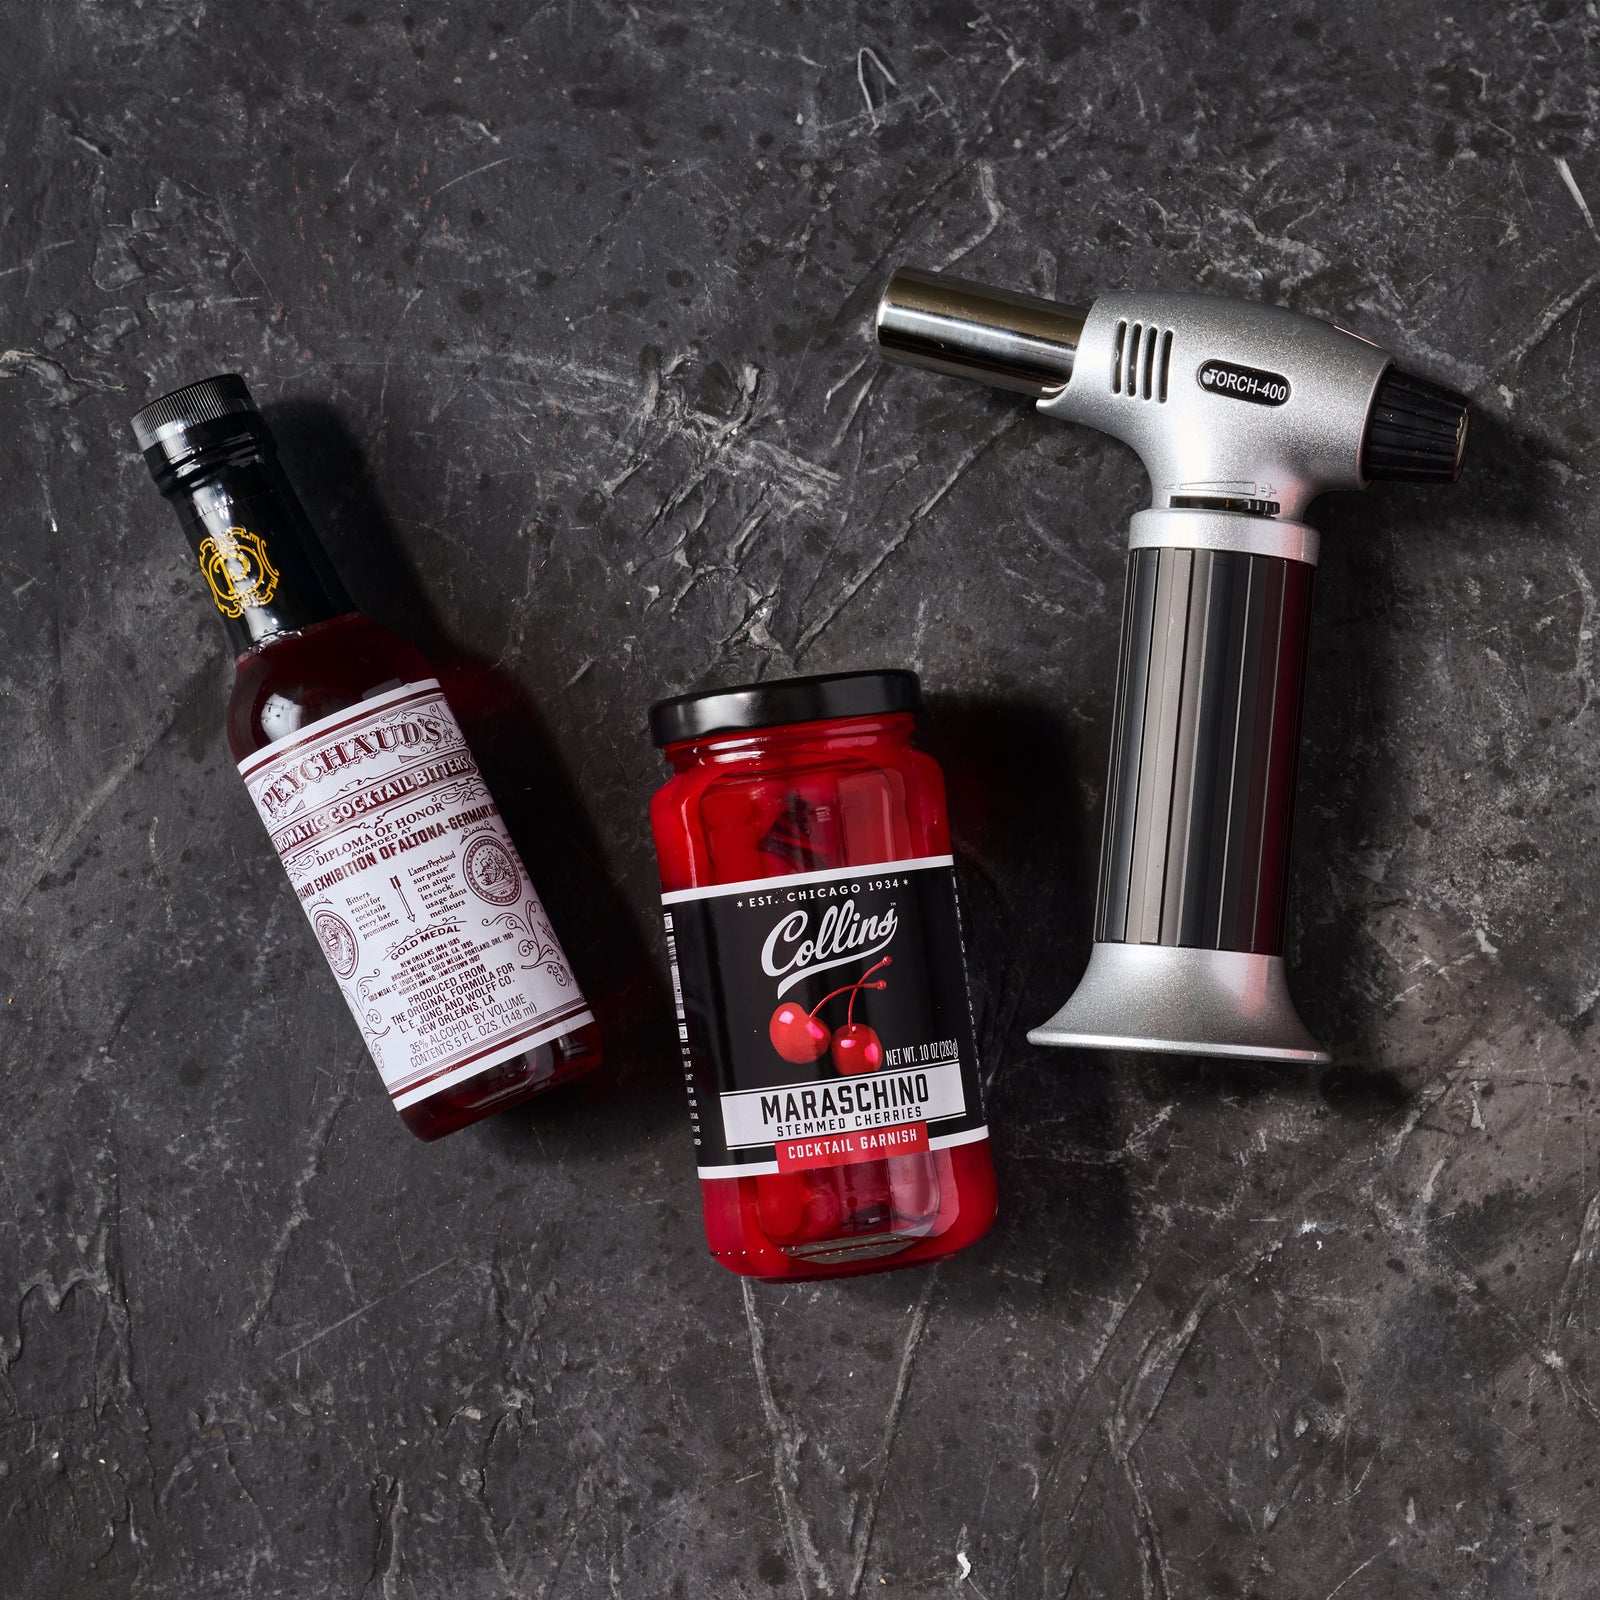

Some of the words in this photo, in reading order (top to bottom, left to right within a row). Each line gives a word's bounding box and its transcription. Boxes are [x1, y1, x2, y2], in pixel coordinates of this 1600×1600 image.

[1208, 368, 1287, 401] TORCH-400
[261, 716, 443, 818] PEYCHAUD'S
[327, 775, 417, 824] COCKTAIL
[415, 755, 471, 788] BITTERS
[316, 833, 373, 866] DIPLOMA
[375, 822, 394, 838] OF
[395, 802, 445, 830] HONOR
[351, 833, 398, 858] AWARDED
[401, 826, 412, 836] AT
[313, 852, 379, 892] EXHIBITION
[378, 841, 398, 861] OF
[413, 875, 425, 885] sur
[417, 883, 431, 893] om
[432, 872, 456, 887] atique
[345, 891, 371, 906] Bitters
[350, 900, 370, 915] equal
[370, 896, 381, 907] for
[425, 897, 447, 910] usage
[449, 888, 468, 900] dans
[429, 900, 466, 918] meilleurs
[749, 895, 779, 908] EST.
[786, 883, 861, 902] CHICAGO
[868, 878, 899, 892] 1934
[355, 903, 387, 923] cocktails
[359, 919, 377, 931] every
[377, 911, 391, 922] bar
[362, 918, 400, 941] prominence
[390, 939, 419, 961] GOLD
[419, 925, 461, 943] MEDAL
[399, 959, 412, 969] NEW
[411, 948, 435, 964] ORLEANS
[761, 899, 898, 999] Collins
[377, 986, 392, 998] MEDAL
[431, 961, 446, 973] GOLD
[390, 968, 410, 982] BRONZE
[409, 961, 427, 974] MEDAL
[398, 982, 419, 997] HIGHEST
[438, 960, 469, 978] JAMESTOWN
[407, 976, 457, 1007] PRODUCED
[458, 963, 487, 983] FROM
[390, 1011, 408, 1026] THE
[407, 992, 450, 1019] ORIGINAL
[450, 971, 496, 998] FORMULA
[495, 962, 515, 978] FOR
[399, 1024, 409, 1034] L.
[408, 1019, 418, 1029] E.
[419, 1006, 443, 1025] JUNG
[444, 996, 464, 1013] AND
[464, 980, 497, 1002] WOLFF
[498, 975, 515, 988] CO.
[409, 1038, 429, 1055] 35%
[429, 1018, 473, 1046] ALCOHOL
[472, 1010, 486, 1025] BY
[486, 993, 527, 1018] VOLUME
[416, 1020, 437, 1037] NEW
[438, 1001, 483, 1027] ORLEANS,
[481, 994, 496, 1007] LA
[410, 1040, 454, 1068] CONTENTS
[454, 1036, 462, 1048] 5
[461, 1031, 478, 1044] FL.
[478, 1020, 501, 1037] OZS.
[501, 1009, 523, 1027] (148
[522, 1001, 538, 1017] ml)
[885, 1048, 902, 1067] NET
[902, 1046, 918, 1064] WT.
[918, 1045, 929, 1061] 10
[929, 1043, 939, 1059] OZ
[939, 1038, 959, 1061] (283g)
[760, 1073, 930, 1125] MARASCHINO
[776, 1117, 846, 1137] STEMMED
[854, 1105, 923, 1126] CHERRIES
[788, 1138, 855, 1160] COCKTAIL
[859, 1128, 918, 1149] GARNISH
